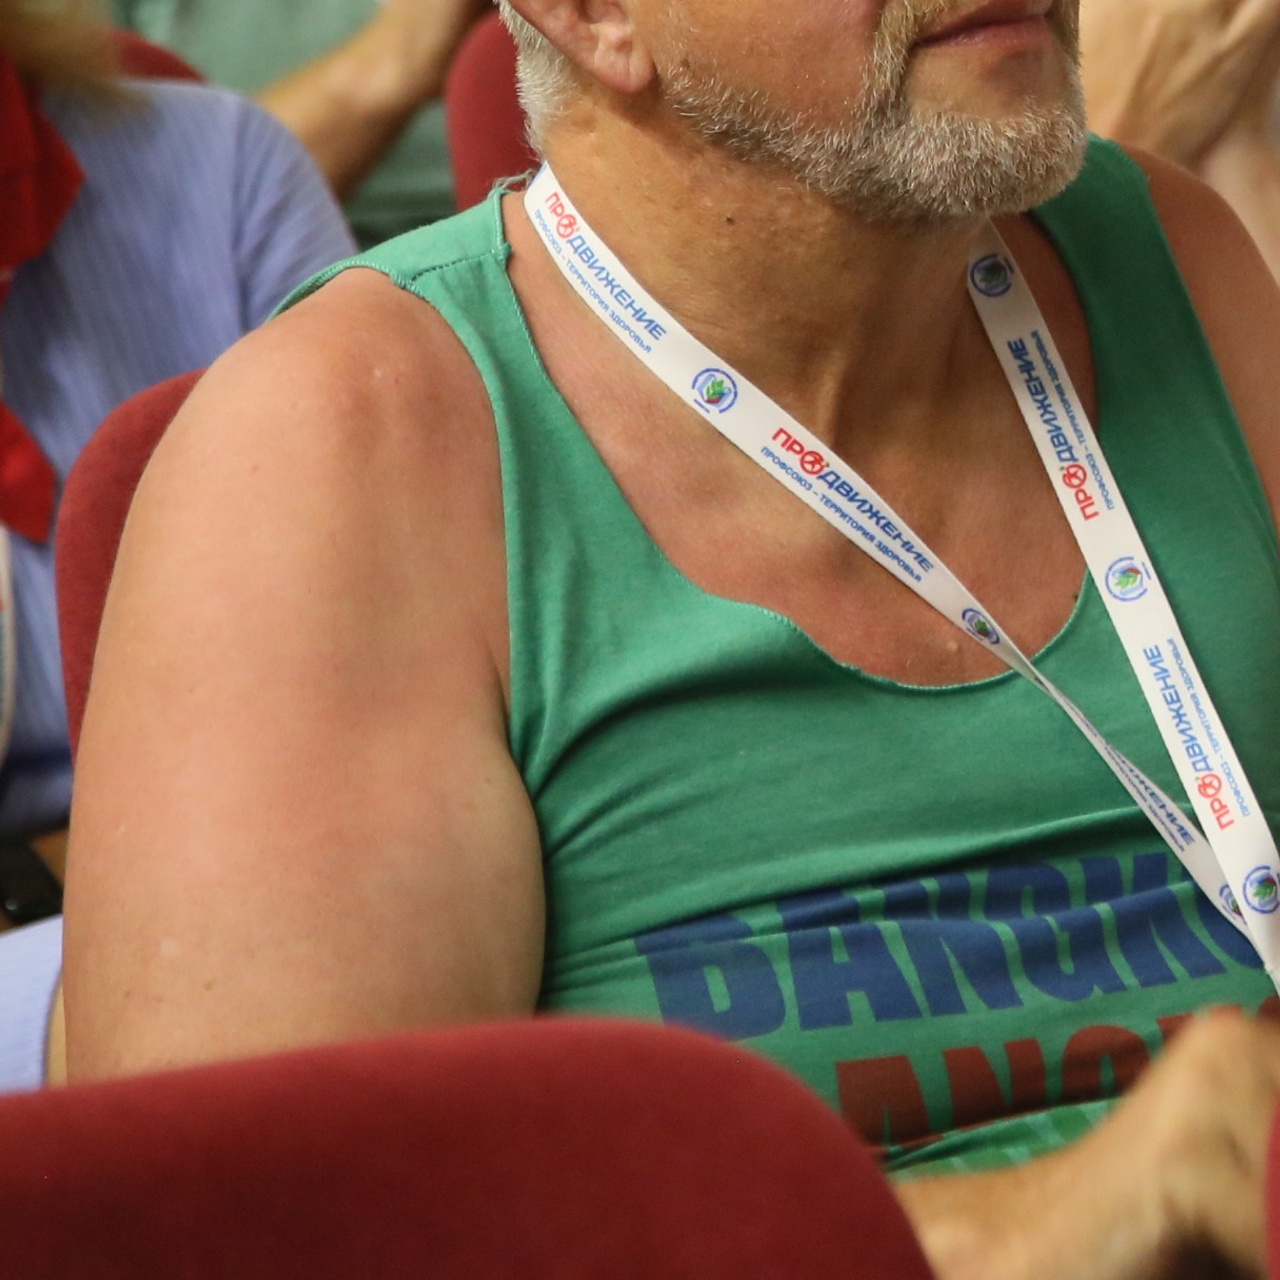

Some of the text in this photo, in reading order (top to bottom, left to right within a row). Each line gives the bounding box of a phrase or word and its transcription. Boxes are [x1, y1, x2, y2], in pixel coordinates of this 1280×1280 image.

[534, 209, 562, 255] ПРОФСОЮЗ
[566, 259, 610, 312] ТЕРРИТОРИЯ
[608, 311, 652, 354] ЗДОРОВЬЯ
[545, 192, 667, 341] ПРОДВИЖЕНИЕ
[772, 428, 934, 573] ПРОДВИЖЕНИЕ
[1007, 338, 1099, 521] ПРОДВИЖЕНИЕ
[761, 446, 813, 492] ПРОФСОЮЗ
[819, 494, 876, 544] ТЕРРИТОРИЯ
[875, 540, 922, 583] ЗДОРОВЬЯ
[1166, 637, 1194, 691] ЗДОРОВЬЯ
[1190, 691, 1221, 754] ТЕРРИТОРИЯ
[1143, 644, 1245, 830] ПРОДВИЖЕНИЕ
[1221, 761, 1250, 817] ПРОФСОЮЗ
